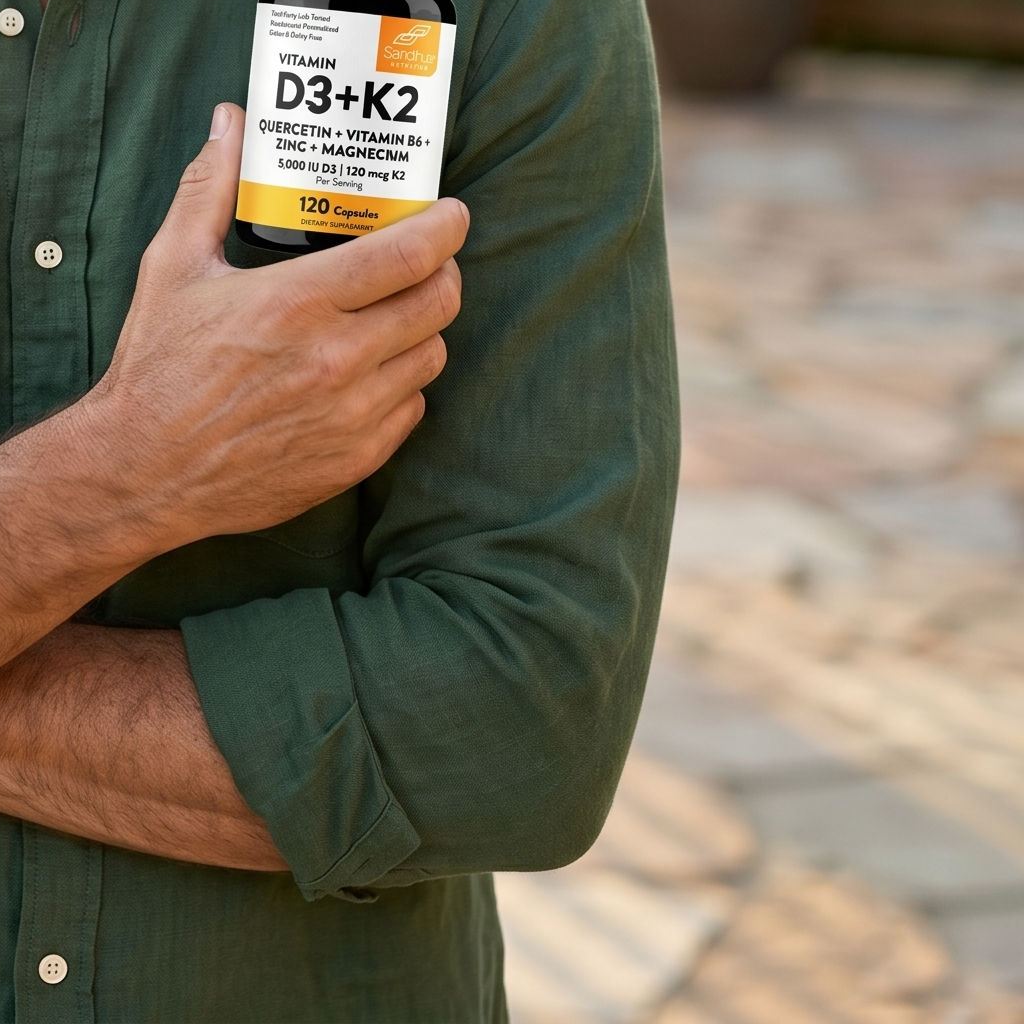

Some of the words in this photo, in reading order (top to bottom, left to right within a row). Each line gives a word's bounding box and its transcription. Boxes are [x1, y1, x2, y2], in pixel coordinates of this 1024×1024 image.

[279, 53, 336, 70] VITAMIN
[276, 71, 419, 123] D3+K2
[259, 119, 332, 139] QUERCETIN
[346, 129, 405, 146] VITAMIN
[407, 135, 423, 147] B6
[276, 138, 307, 153] ZINC
[278, 158, 306, 171] 5,000
[307, 162, 319, 173] IU
[322, 164, 337, 174] D3
[346, 166, 366, 177] 120
[368, 171, 390, 182] mcg
[391, 170, 406, 181] K2
[315, 176, 330, 185] Per
[299, 196, 330, 214] 120
